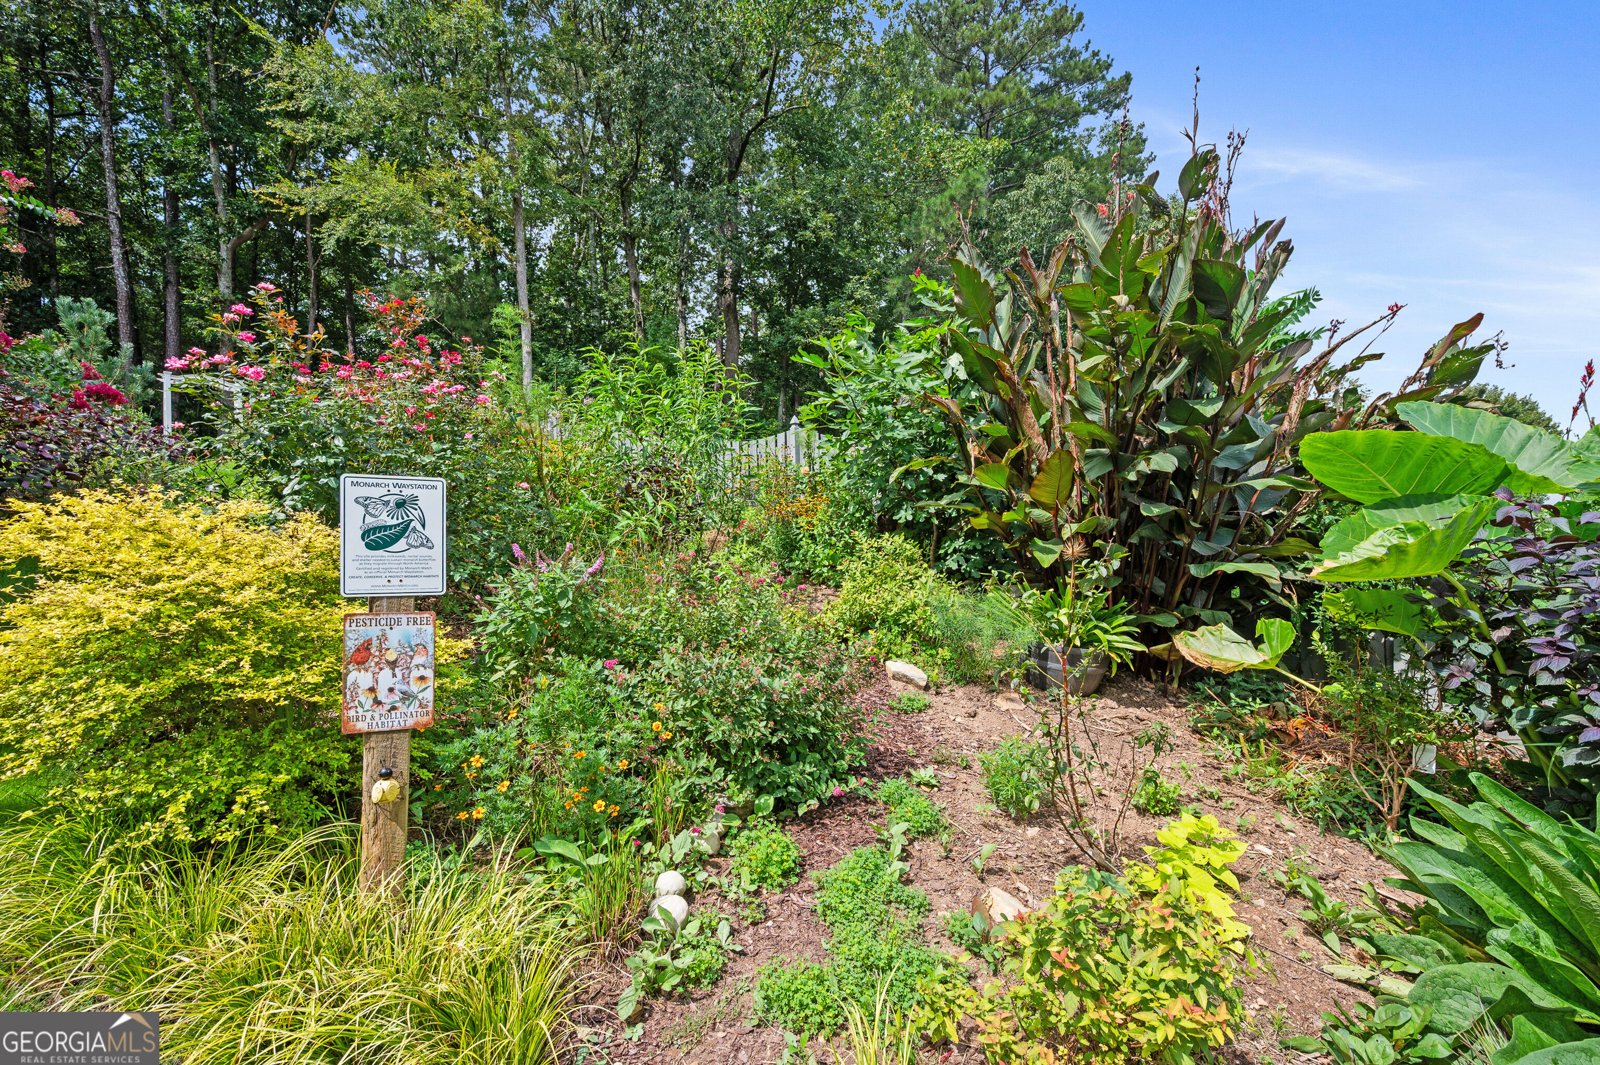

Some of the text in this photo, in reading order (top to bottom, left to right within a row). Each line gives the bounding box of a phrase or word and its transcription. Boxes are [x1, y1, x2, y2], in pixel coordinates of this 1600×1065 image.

[350, 480, 438, 490] MONARCH WAYSTATION
[348, 616, 431, 628] PESTICIDE FREE
[347, 714, 367, 723] BIRD
[378, 710, 430, 720] POLLINATOR
[367, 720, 408, 730] HABITAT
